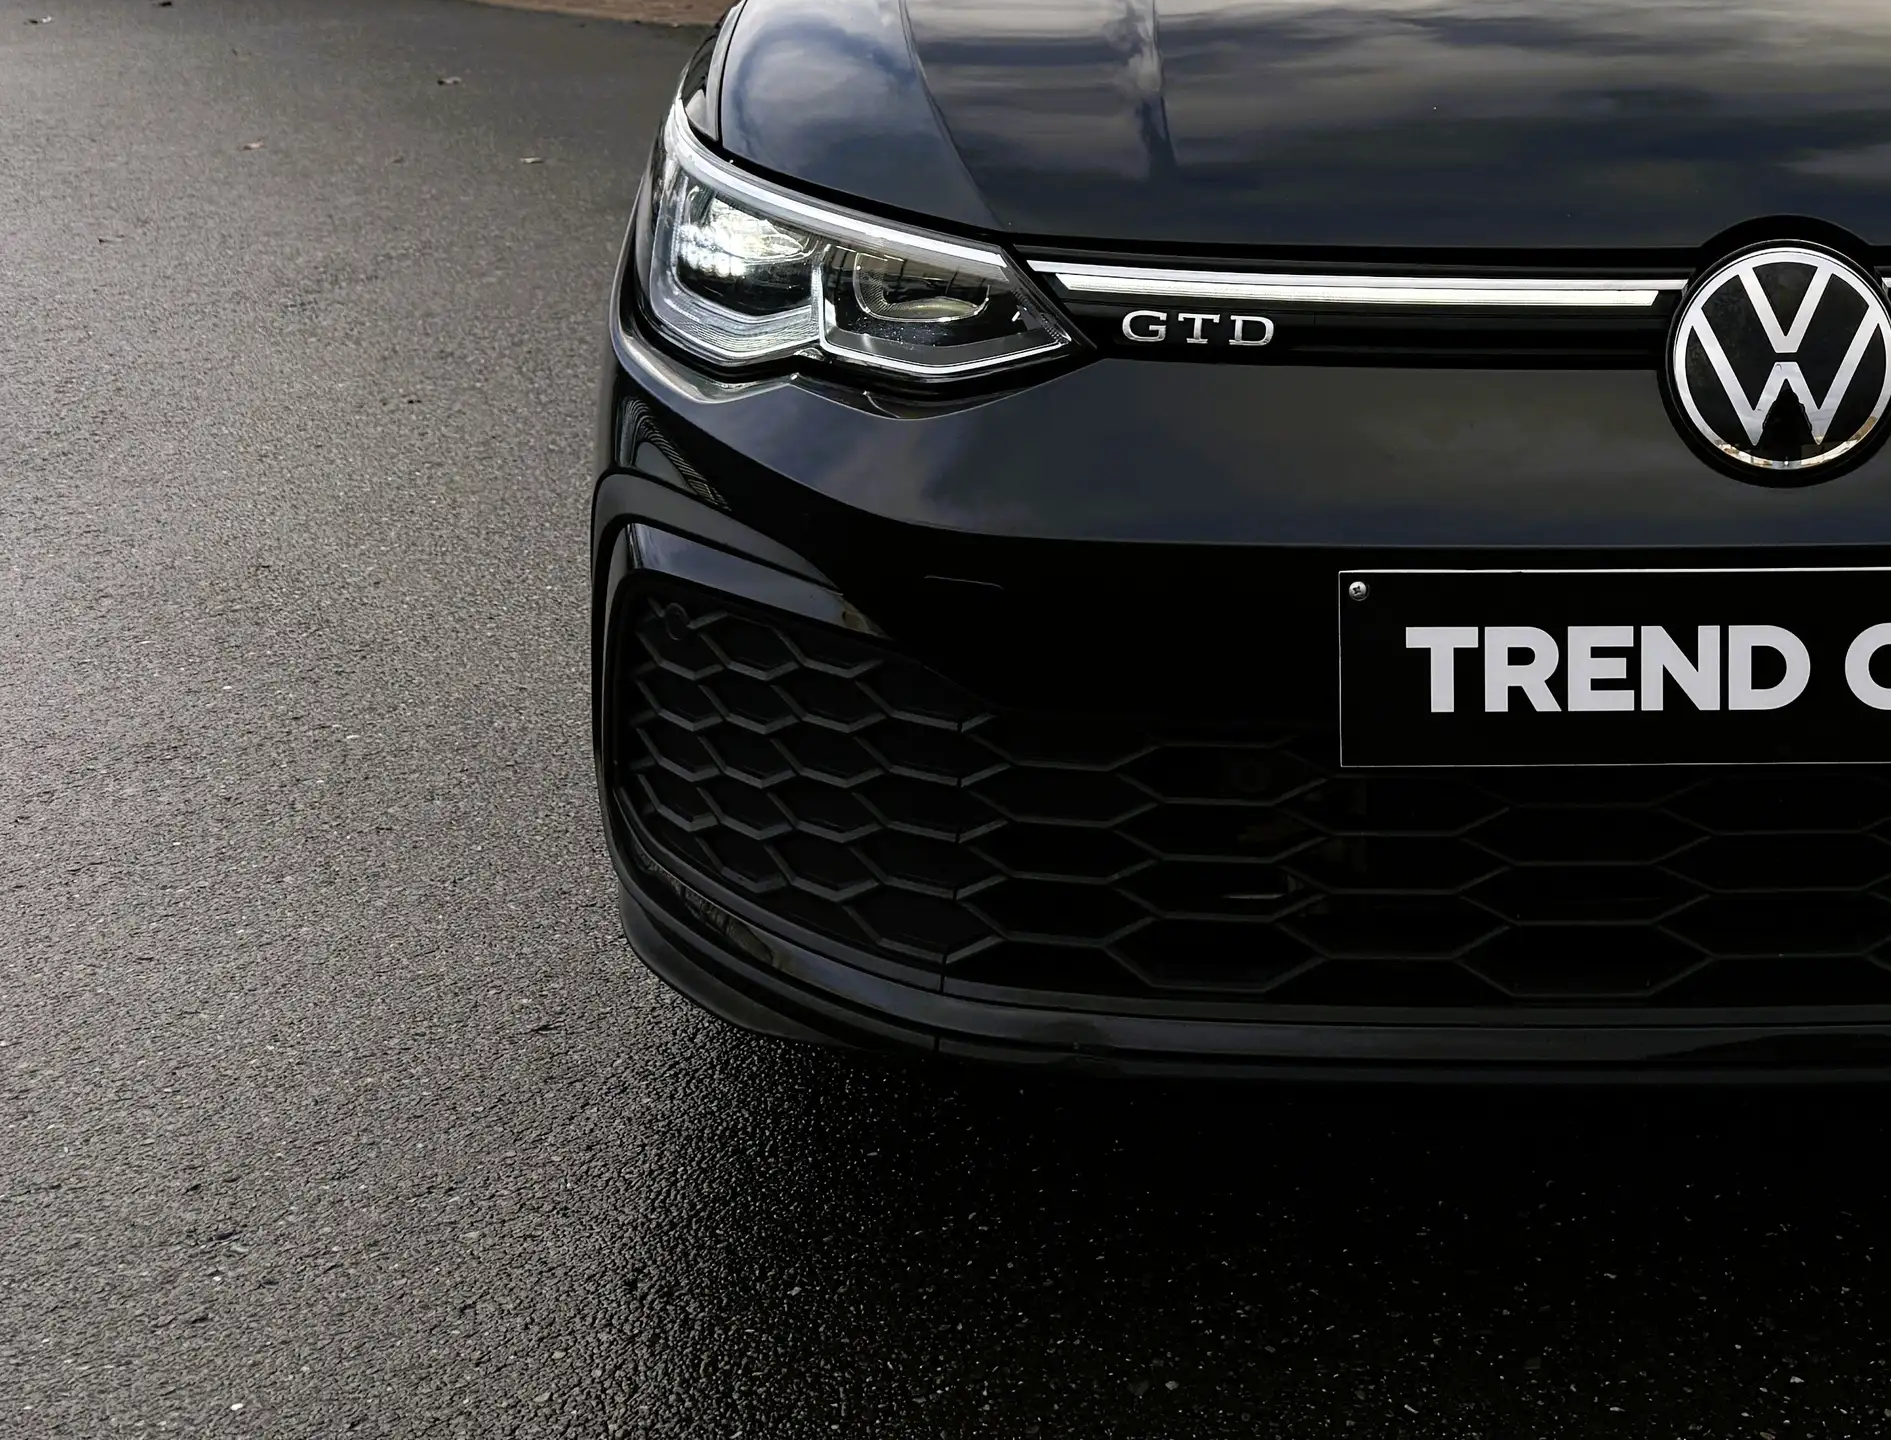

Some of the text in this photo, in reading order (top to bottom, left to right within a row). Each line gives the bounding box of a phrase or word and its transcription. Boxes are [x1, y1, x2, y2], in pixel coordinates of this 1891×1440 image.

[1122, 310, 1275, 346] GTD
[1684, 257, 1888, 453] VW
[1405, 624, 1811, 713] TREND
